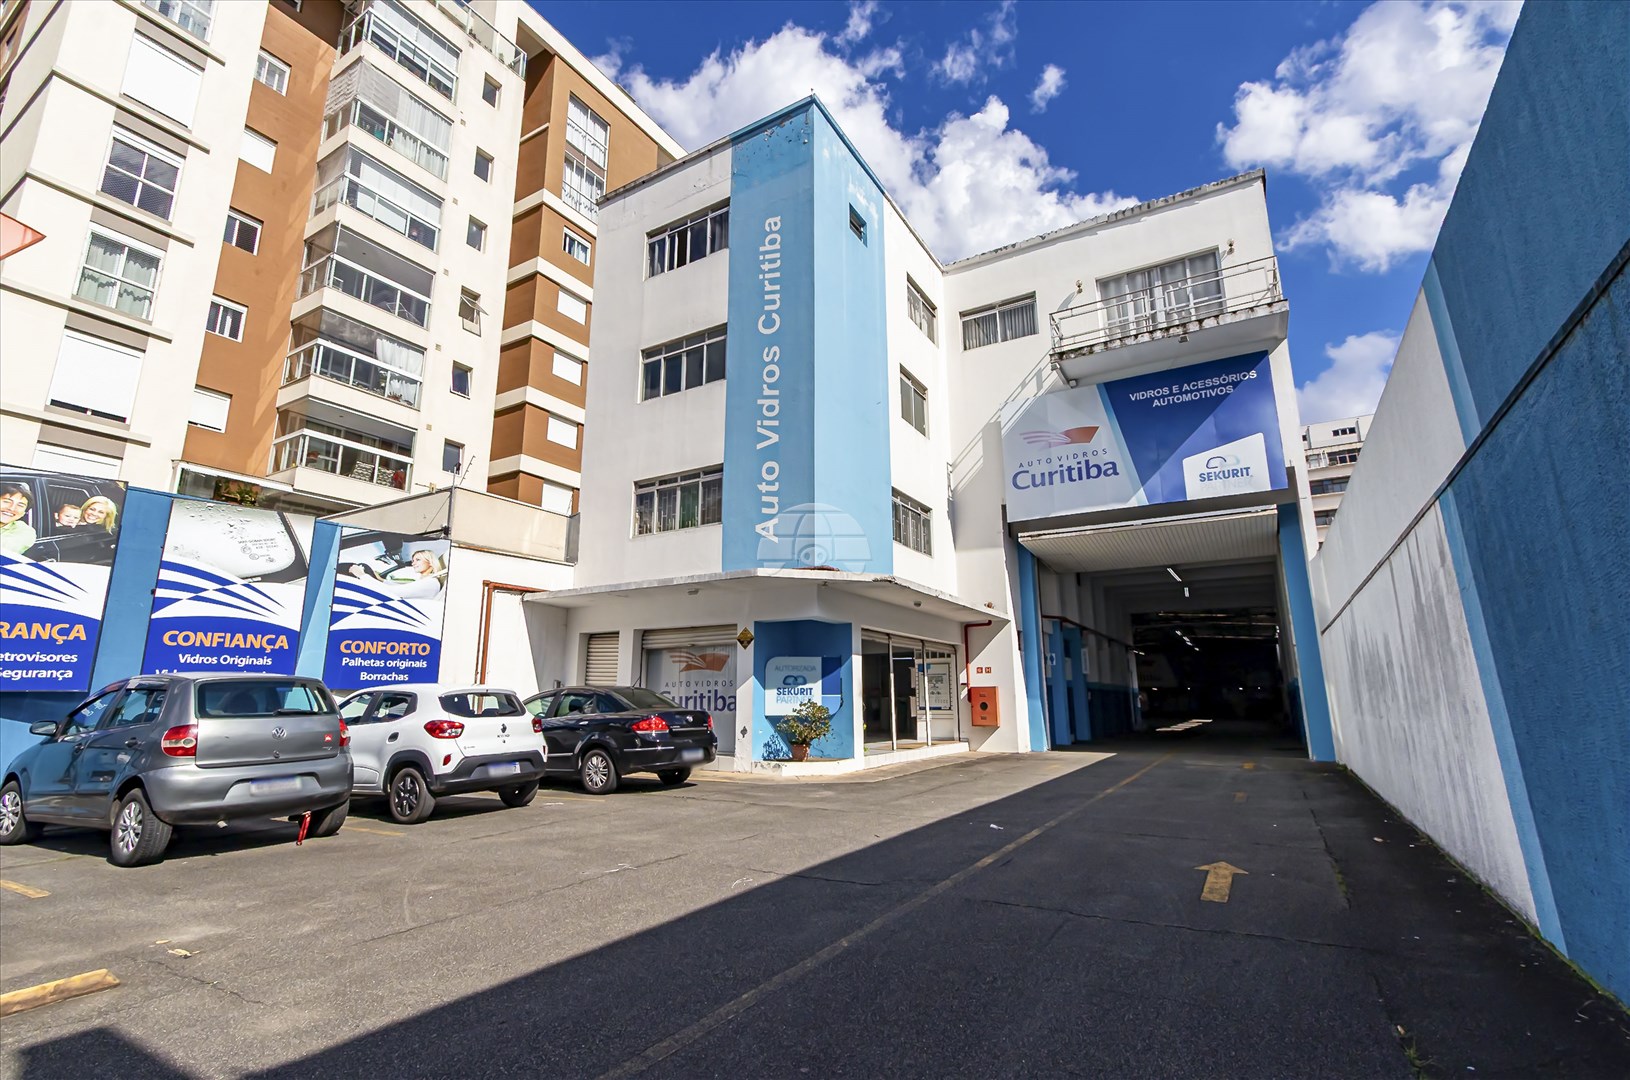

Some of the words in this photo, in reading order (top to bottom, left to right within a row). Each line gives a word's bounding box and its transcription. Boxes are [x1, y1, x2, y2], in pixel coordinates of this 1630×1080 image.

[758, 215, 781, 335] Curitiba
[1129, 386, 1170, 401] VIDROS
[1172, 384, 1180, 394] E
[1182, 369, 1258, 392] ACESSÓRIOS
[1152, 384, 1234, 408] AUTOMOTIVOS
[756, 344, 780, 450] Vidros
[1011, 459, 1120, 491] Curitiba
[1198, 466, 1251, 483] SEKURIT
[755, 460, 780, 544] Auto
[0, 621, 87, 645] RANÇA
[162, 630, 290, 653] CONFIANÇA
[340, 640, 431, 656] CONFORTO
[178, 653, 218, 666] Vidros
[219, 655, 273, 669] Originais
[341, 657, 385, 669] Palhetas
[386, 659, 428, 672] originais
[0, 667, 74, 681] egurança
[360, 671, 410, 682] Borrachas
[776, 687, 814, 696] SEKURIT
